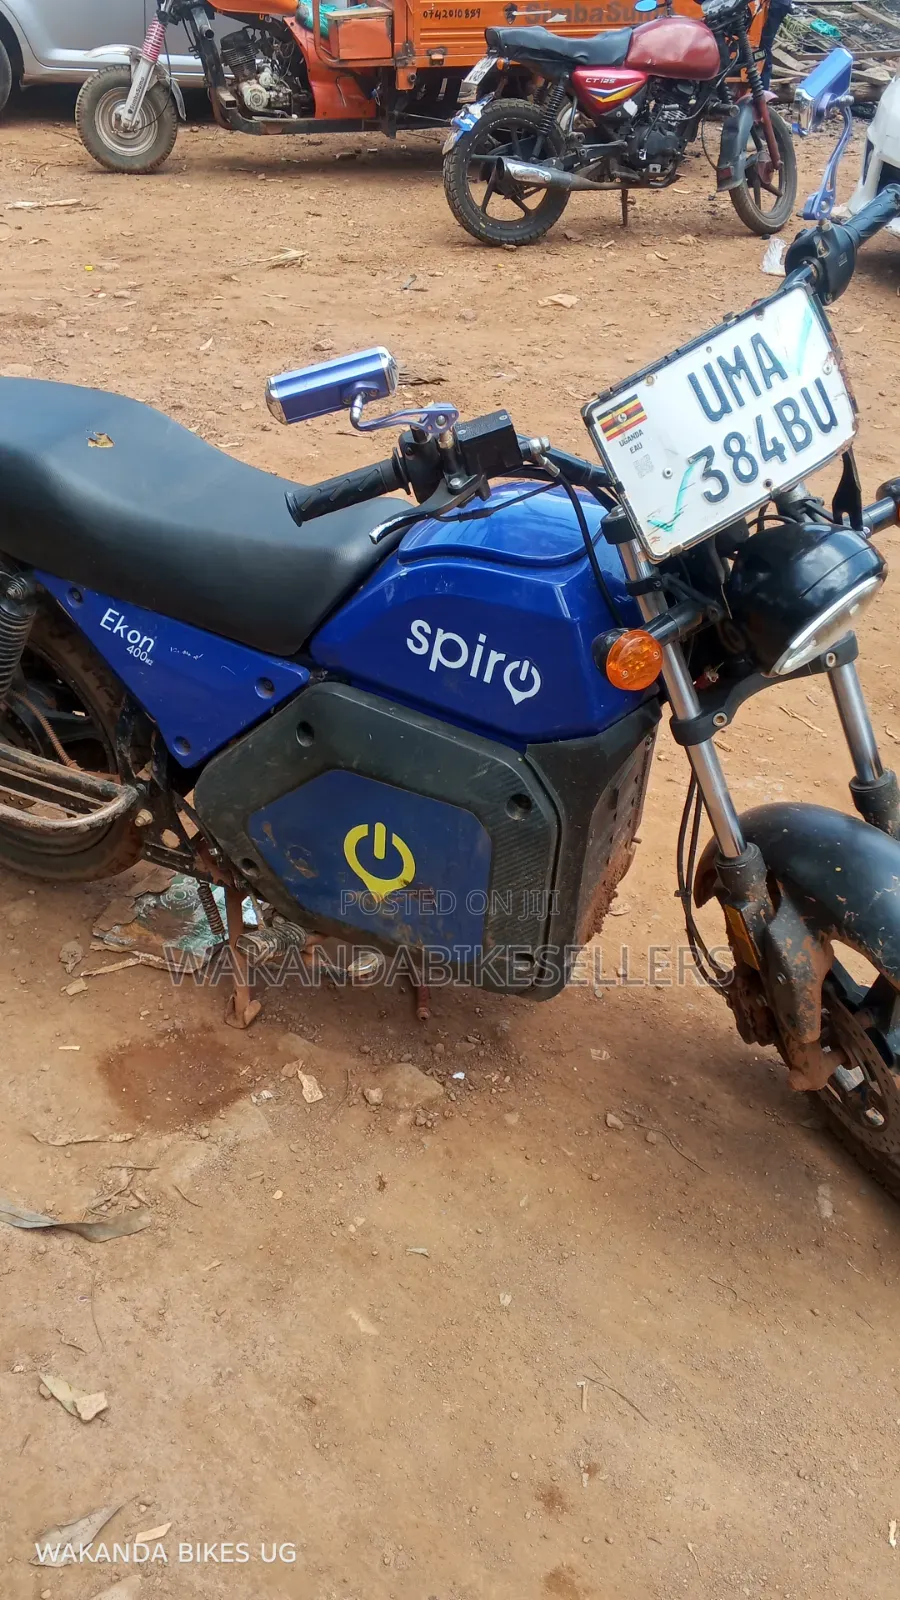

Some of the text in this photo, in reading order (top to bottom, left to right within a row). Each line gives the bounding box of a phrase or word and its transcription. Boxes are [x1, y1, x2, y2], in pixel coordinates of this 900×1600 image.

[687, 332, 788, 424] UMA
[618, 429, 644, 447] UGANDA
[629, 442, 643, 454] EAU
[687, 377, 838, 503] 384BU
[100, 607, 155, 653] Ekon
